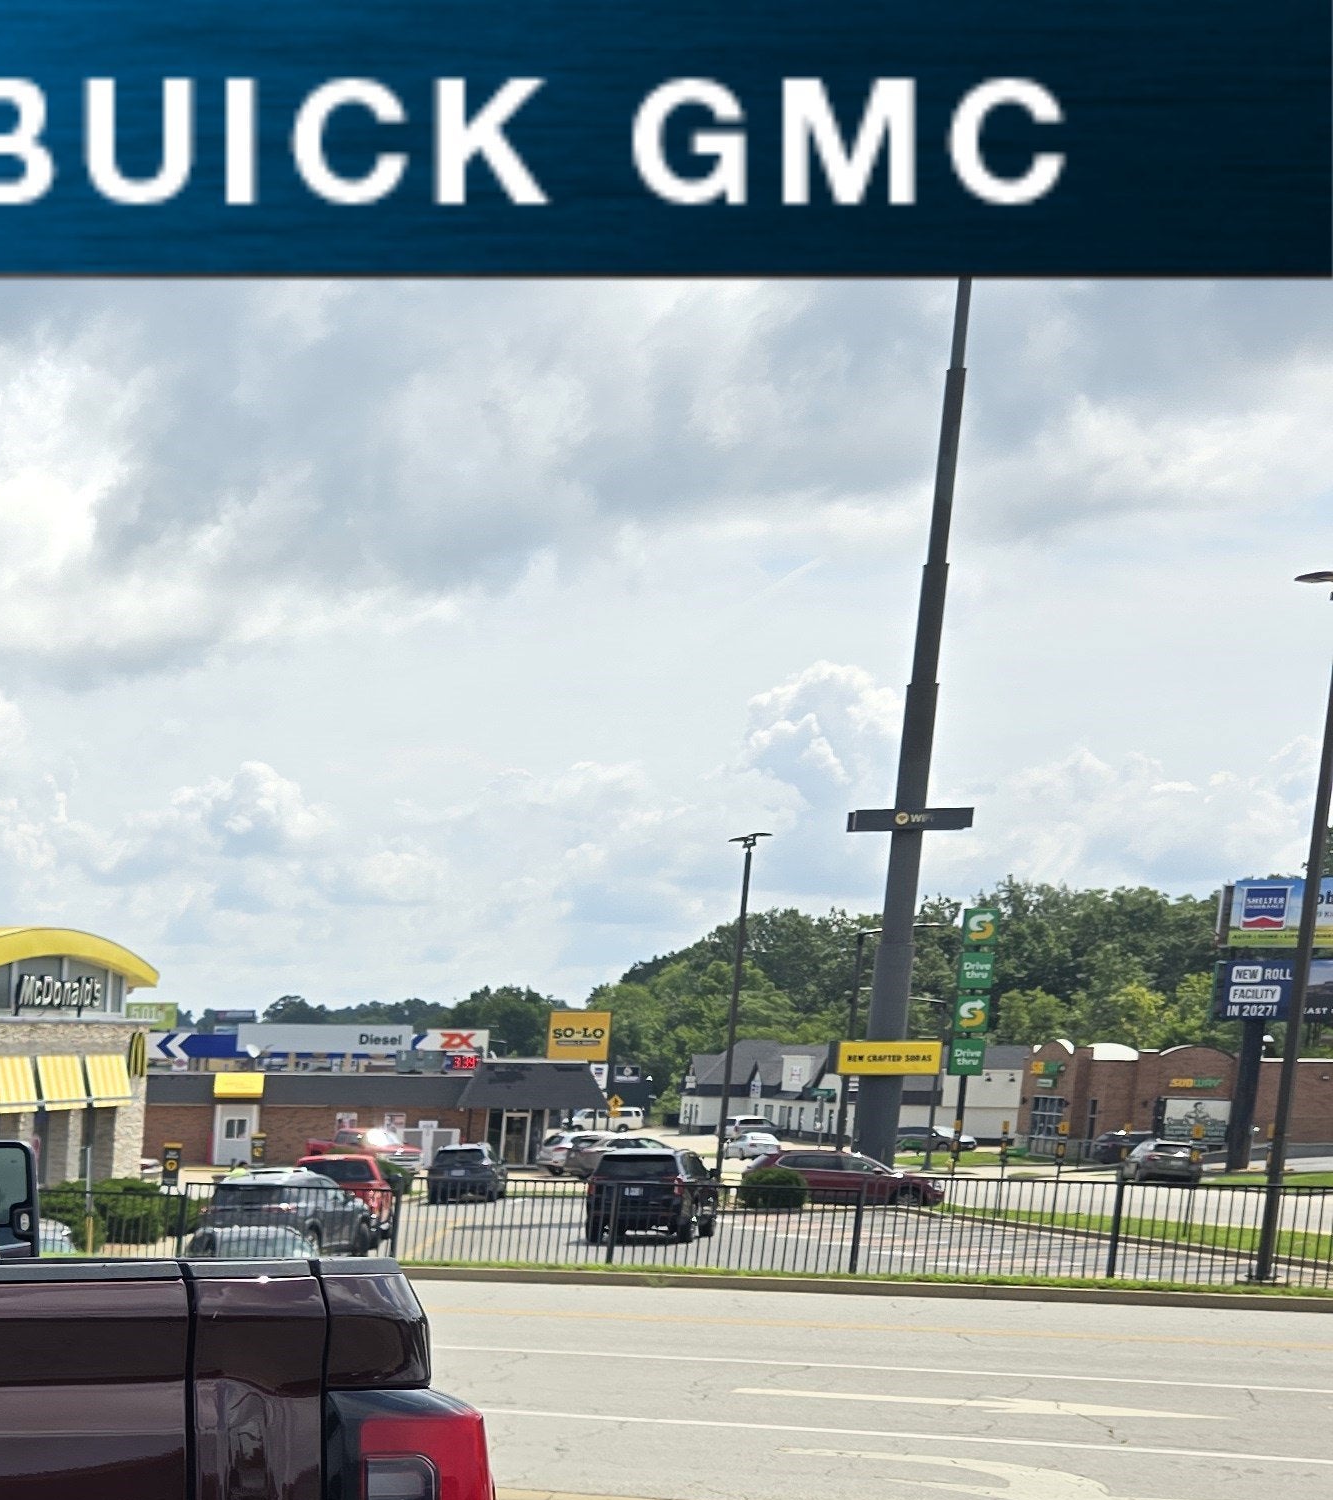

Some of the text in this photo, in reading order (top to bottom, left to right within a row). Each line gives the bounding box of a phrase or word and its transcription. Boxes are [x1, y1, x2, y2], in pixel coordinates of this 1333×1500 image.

[963, 961, 992, 971] Drive
[965, 969, 989, 979] thru
[1234, 968, 1293, 981] NEW ROLL
[19, 974, 101, 1007] McDonald's
[1233, 987, 1277, 999] FACILITY
[1226, 1005, 1240, 1017] IN
[358, 1032, 402, 1046] Diesel
[552, 1026, 605, 1040] SO-LO
[847, 1054, 933, 1062] NEW CRAFTED SODAS
[954, 1048, 982, 1059] Drive
[955, 1056, 979, 1066] thru
